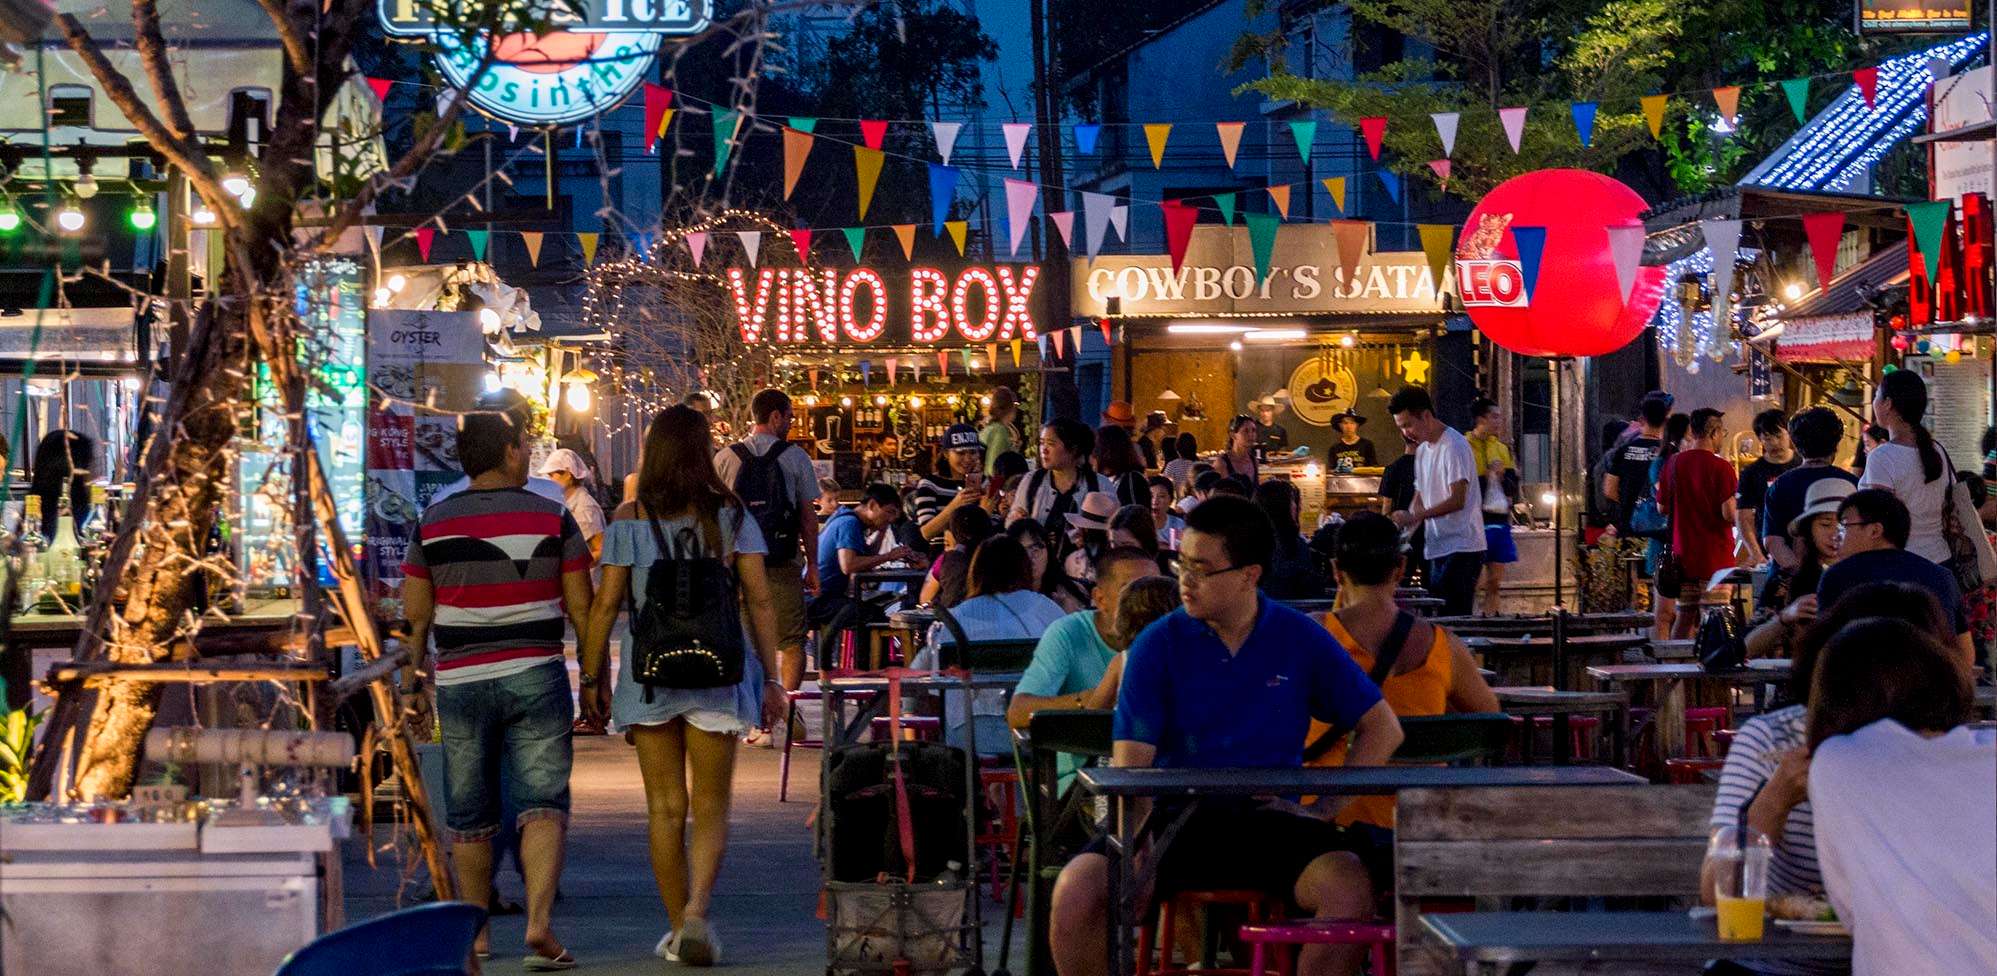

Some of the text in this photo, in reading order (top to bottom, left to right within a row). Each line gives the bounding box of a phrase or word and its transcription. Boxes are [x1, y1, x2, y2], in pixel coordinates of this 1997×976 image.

[1085, 264, 1321, 301] COWBOY'S
[1457, 262, 1524, 304] LEO
[726, 266, 1040, 344] VINO BOX
[390, 330, 442, 346] OYSTER
[380, 438, 409, 447] STYLE
